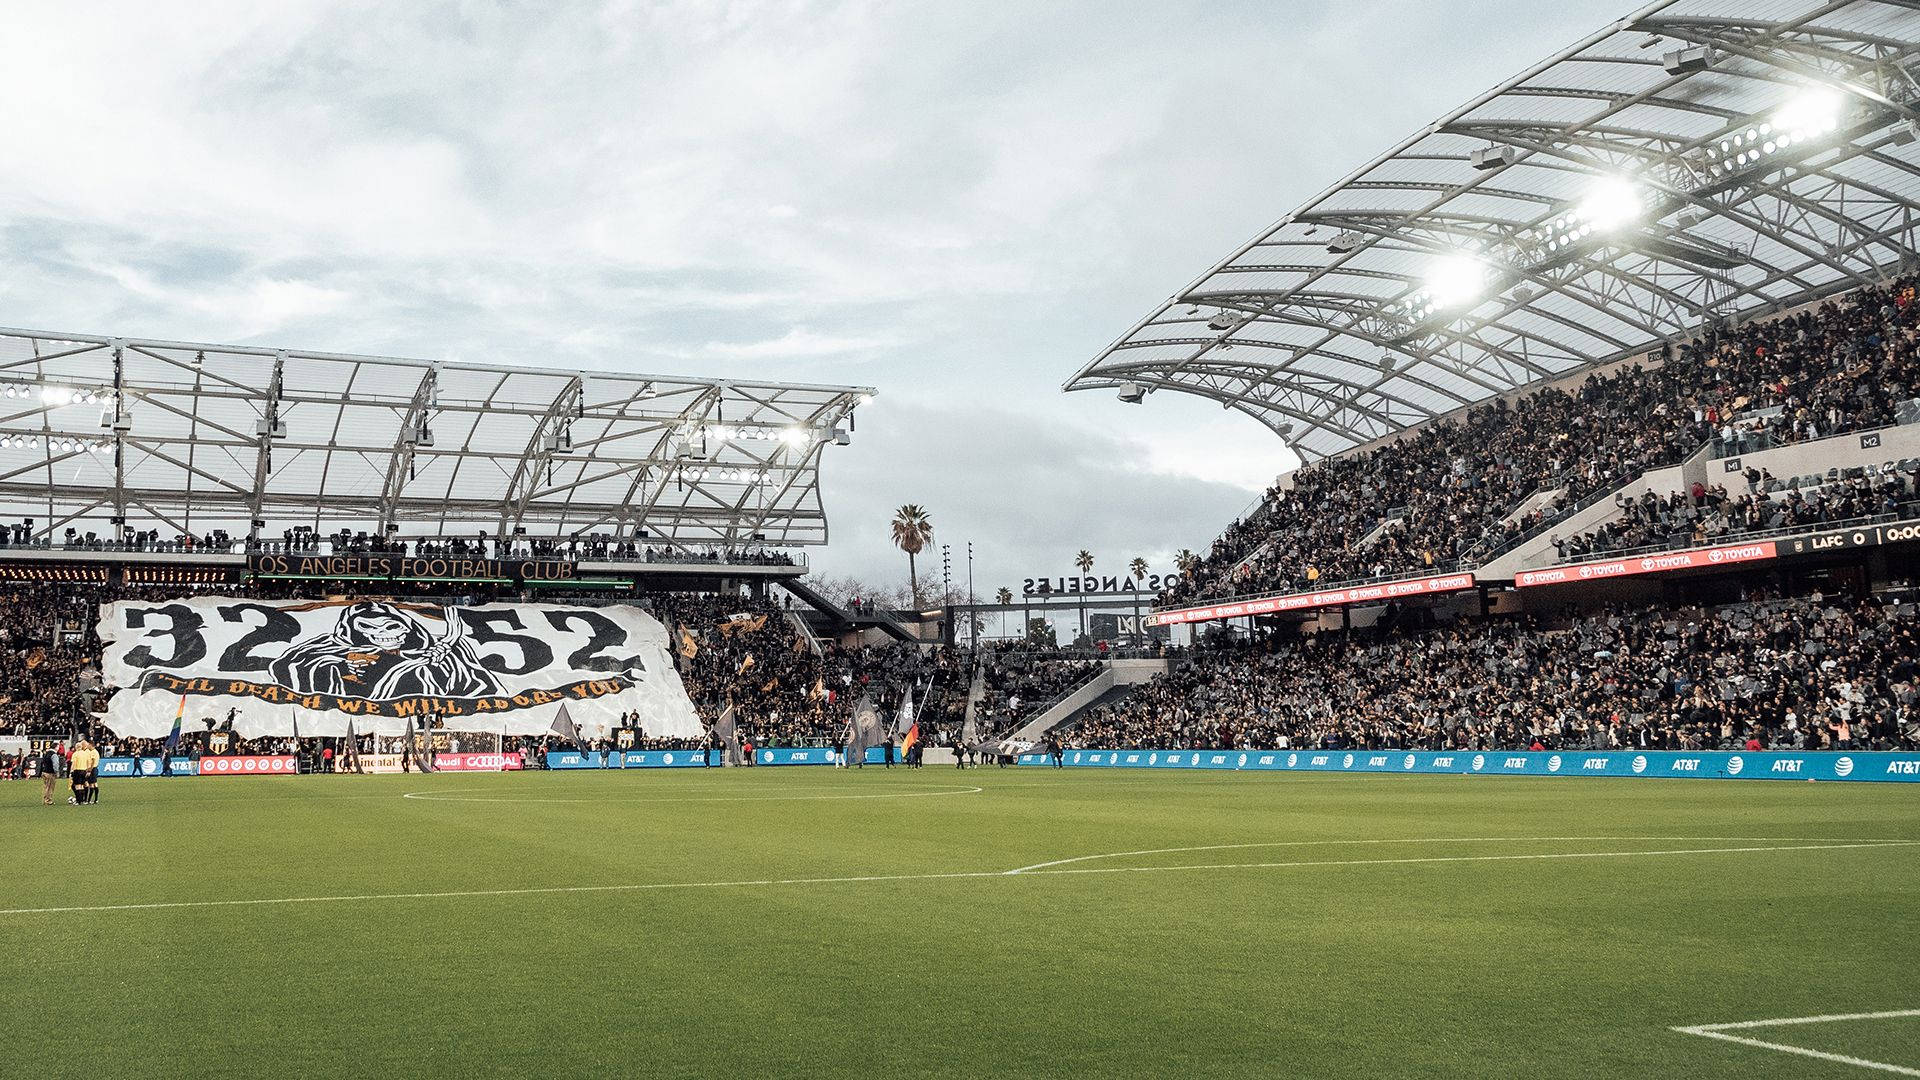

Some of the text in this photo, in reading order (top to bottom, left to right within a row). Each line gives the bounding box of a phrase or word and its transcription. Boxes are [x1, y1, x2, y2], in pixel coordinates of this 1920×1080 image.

[1863, 438, 1877, 446] M2
[1728, 462, 1738, 471] M1
[1812, 535, 1844, 549] LAFC
[1853, 533, 1865, 545] 0
[1723, 546, 1763, 560] TOYOTA
[1655, 555, 1691, 568] TOYOTA
[248, 555, 572, 580] LOS ANGELES FOOTBALL CLUB
[1594, 563, 1626, 575] TOYOTA
[1535, 571, 1566, 582] TOYOTA
[1439, 577, 1468, 588] TOYOTA
[1359, 588, 1382, 598] TOYOTA
[1398, 583, 1423, 593] TOYOTA
[1287, 598, 1308, 607] TOYOTA
[1322, 593, 1345, 602] TOYOTA
[123, 603, 646, 675] 32 52
[160, 675, 214, 692] 'TIL
[229, 681, 320, 708] DEATH
[336, 698, 380, 714] WE
[393, 699, 462, 716] WILL
[572, 680, 620, 698] YOU
[561, 756, 580, 764] AT&T
[690, 754, 704, 762] AT&
[791, 752, 808, 760] AT&T
[1126, 754, 1140, 762] AT&T
[1167, 754, 1180, 763] AT&T
[1210, 756, 1226, 764] AT&T
[1259, 756, 1274, 764] AT&T
[1311, 756, 1328, 765] AT&T
[1368, 756, 1388, 766] AT&T
[104, 762, 130, 772] AT&T
[435, 758, 460, 766] Audi
[1432, 757, 1454, 767] AT&T
[1504, 758, 1528, 768] AT&T
[1583, 758, 1608, 770] AT&T
[1672, 759, 1700, 770] AT&T
[1772, 760, 1804, 772] AT&T
[1886, 761, 1920, 774] AT&T
